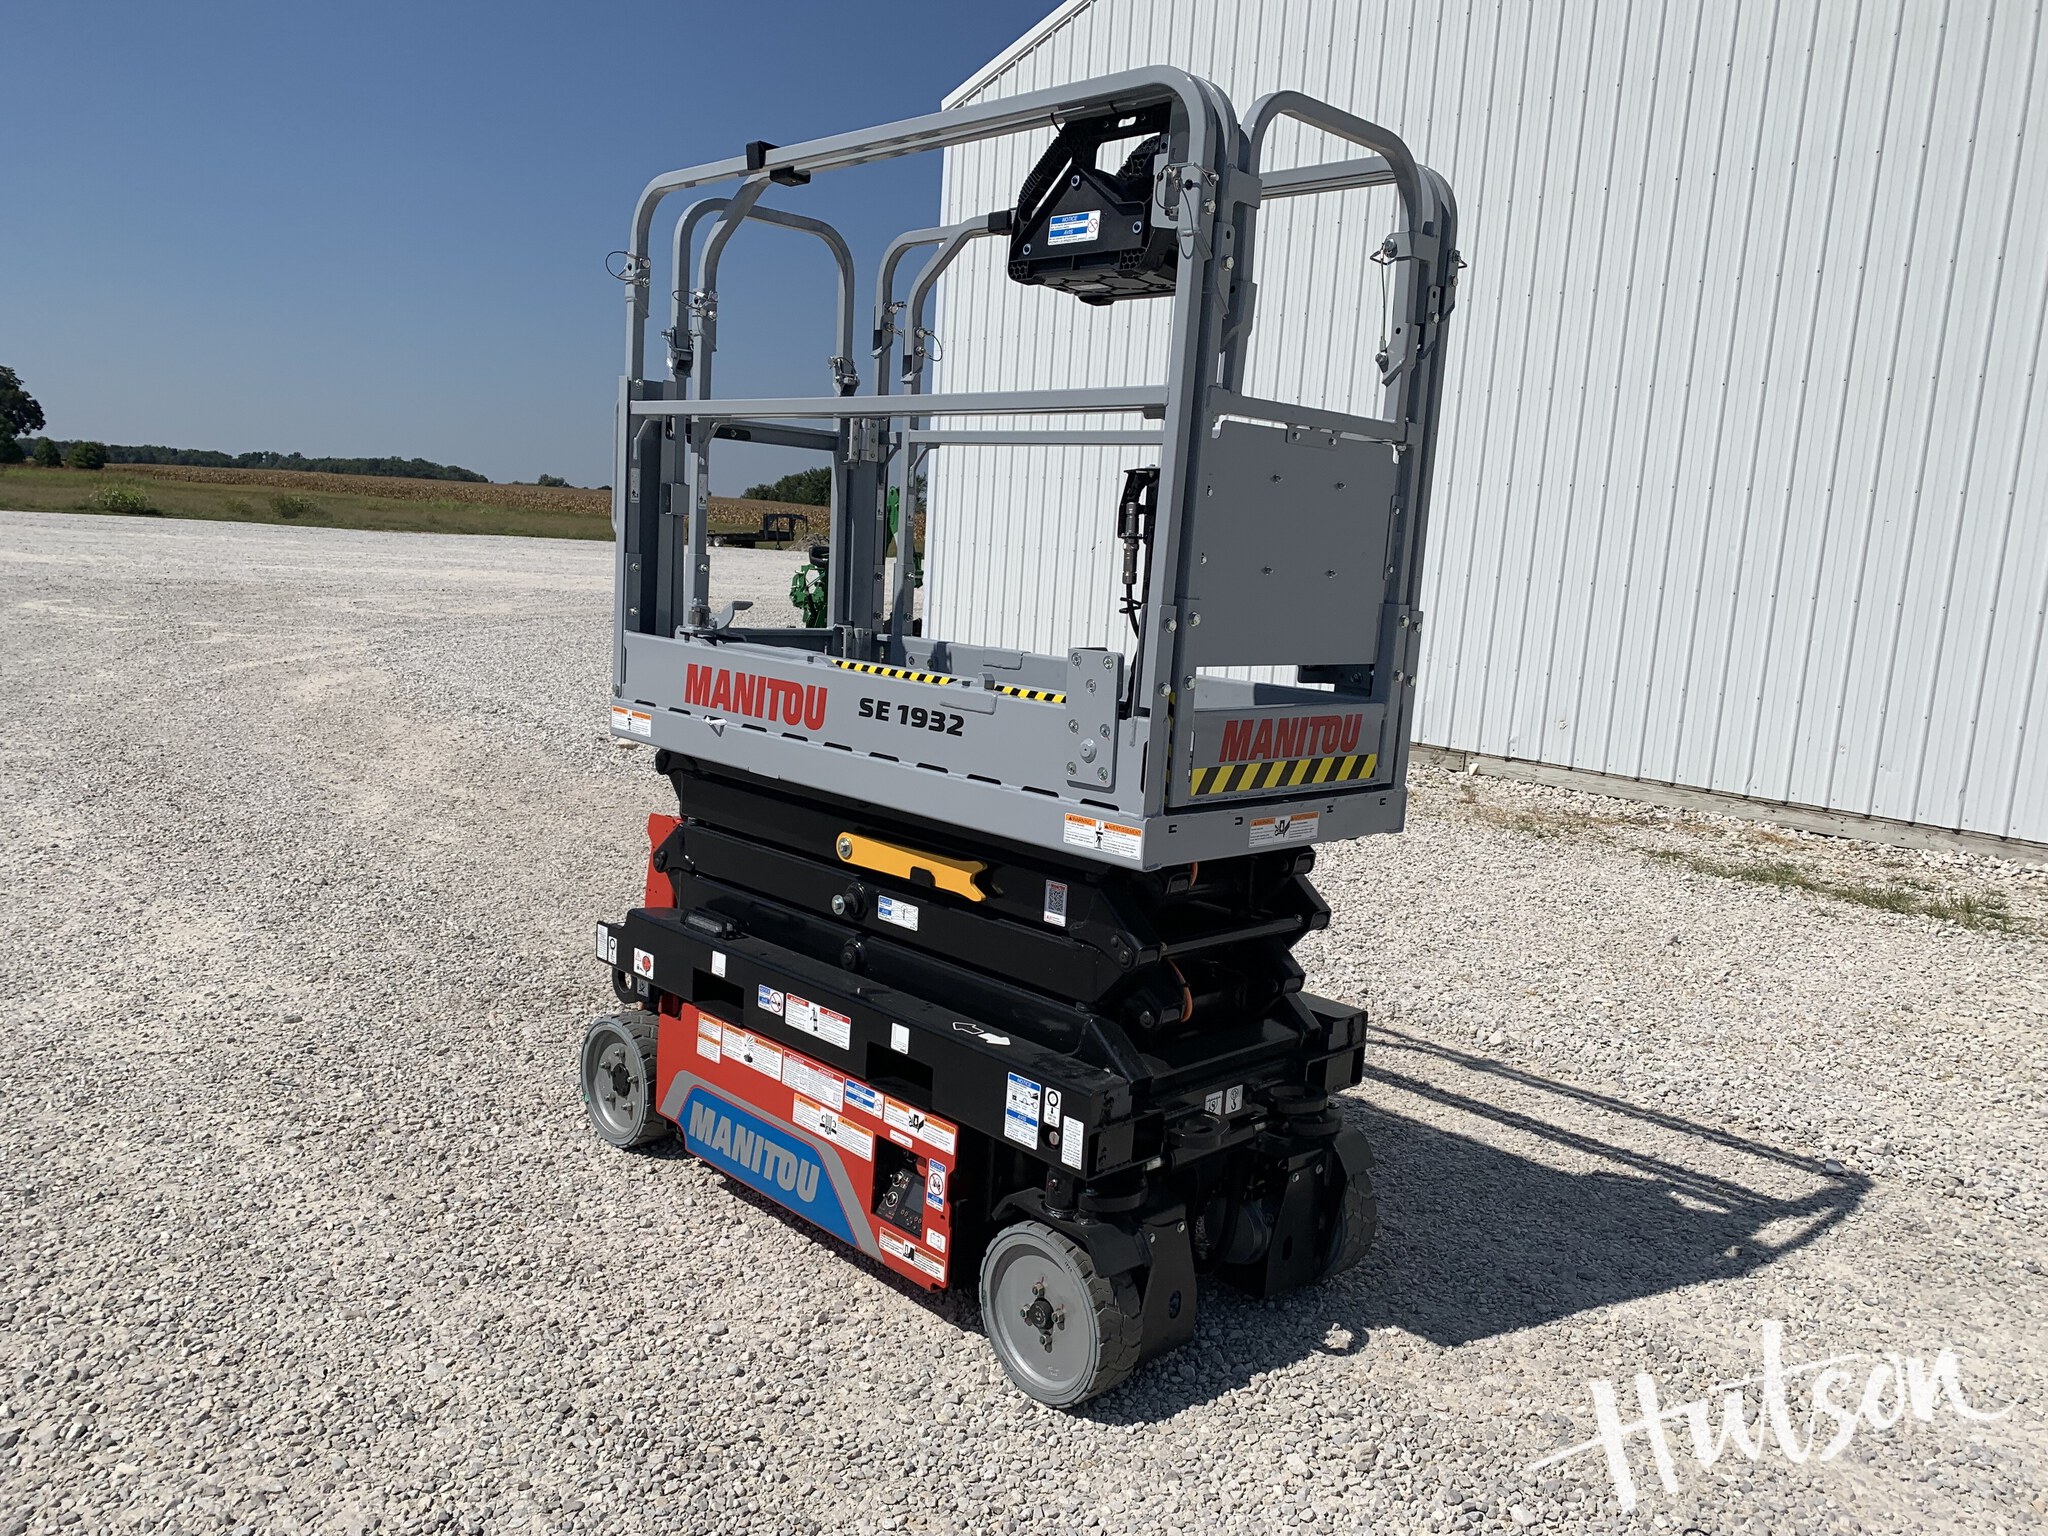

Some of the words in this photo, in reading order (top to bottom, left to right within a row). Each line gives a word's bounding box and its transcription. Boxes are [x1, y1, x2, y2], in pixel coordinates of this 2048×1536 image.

[684, 663, 828, 731] MANITOU
[858, 697, 891, 722] SE
[896, 703, 965, 738] 1932
[1218, 713, 1364, 763] MANITOU
[688, 1101, 821, 1203] MANITOU
